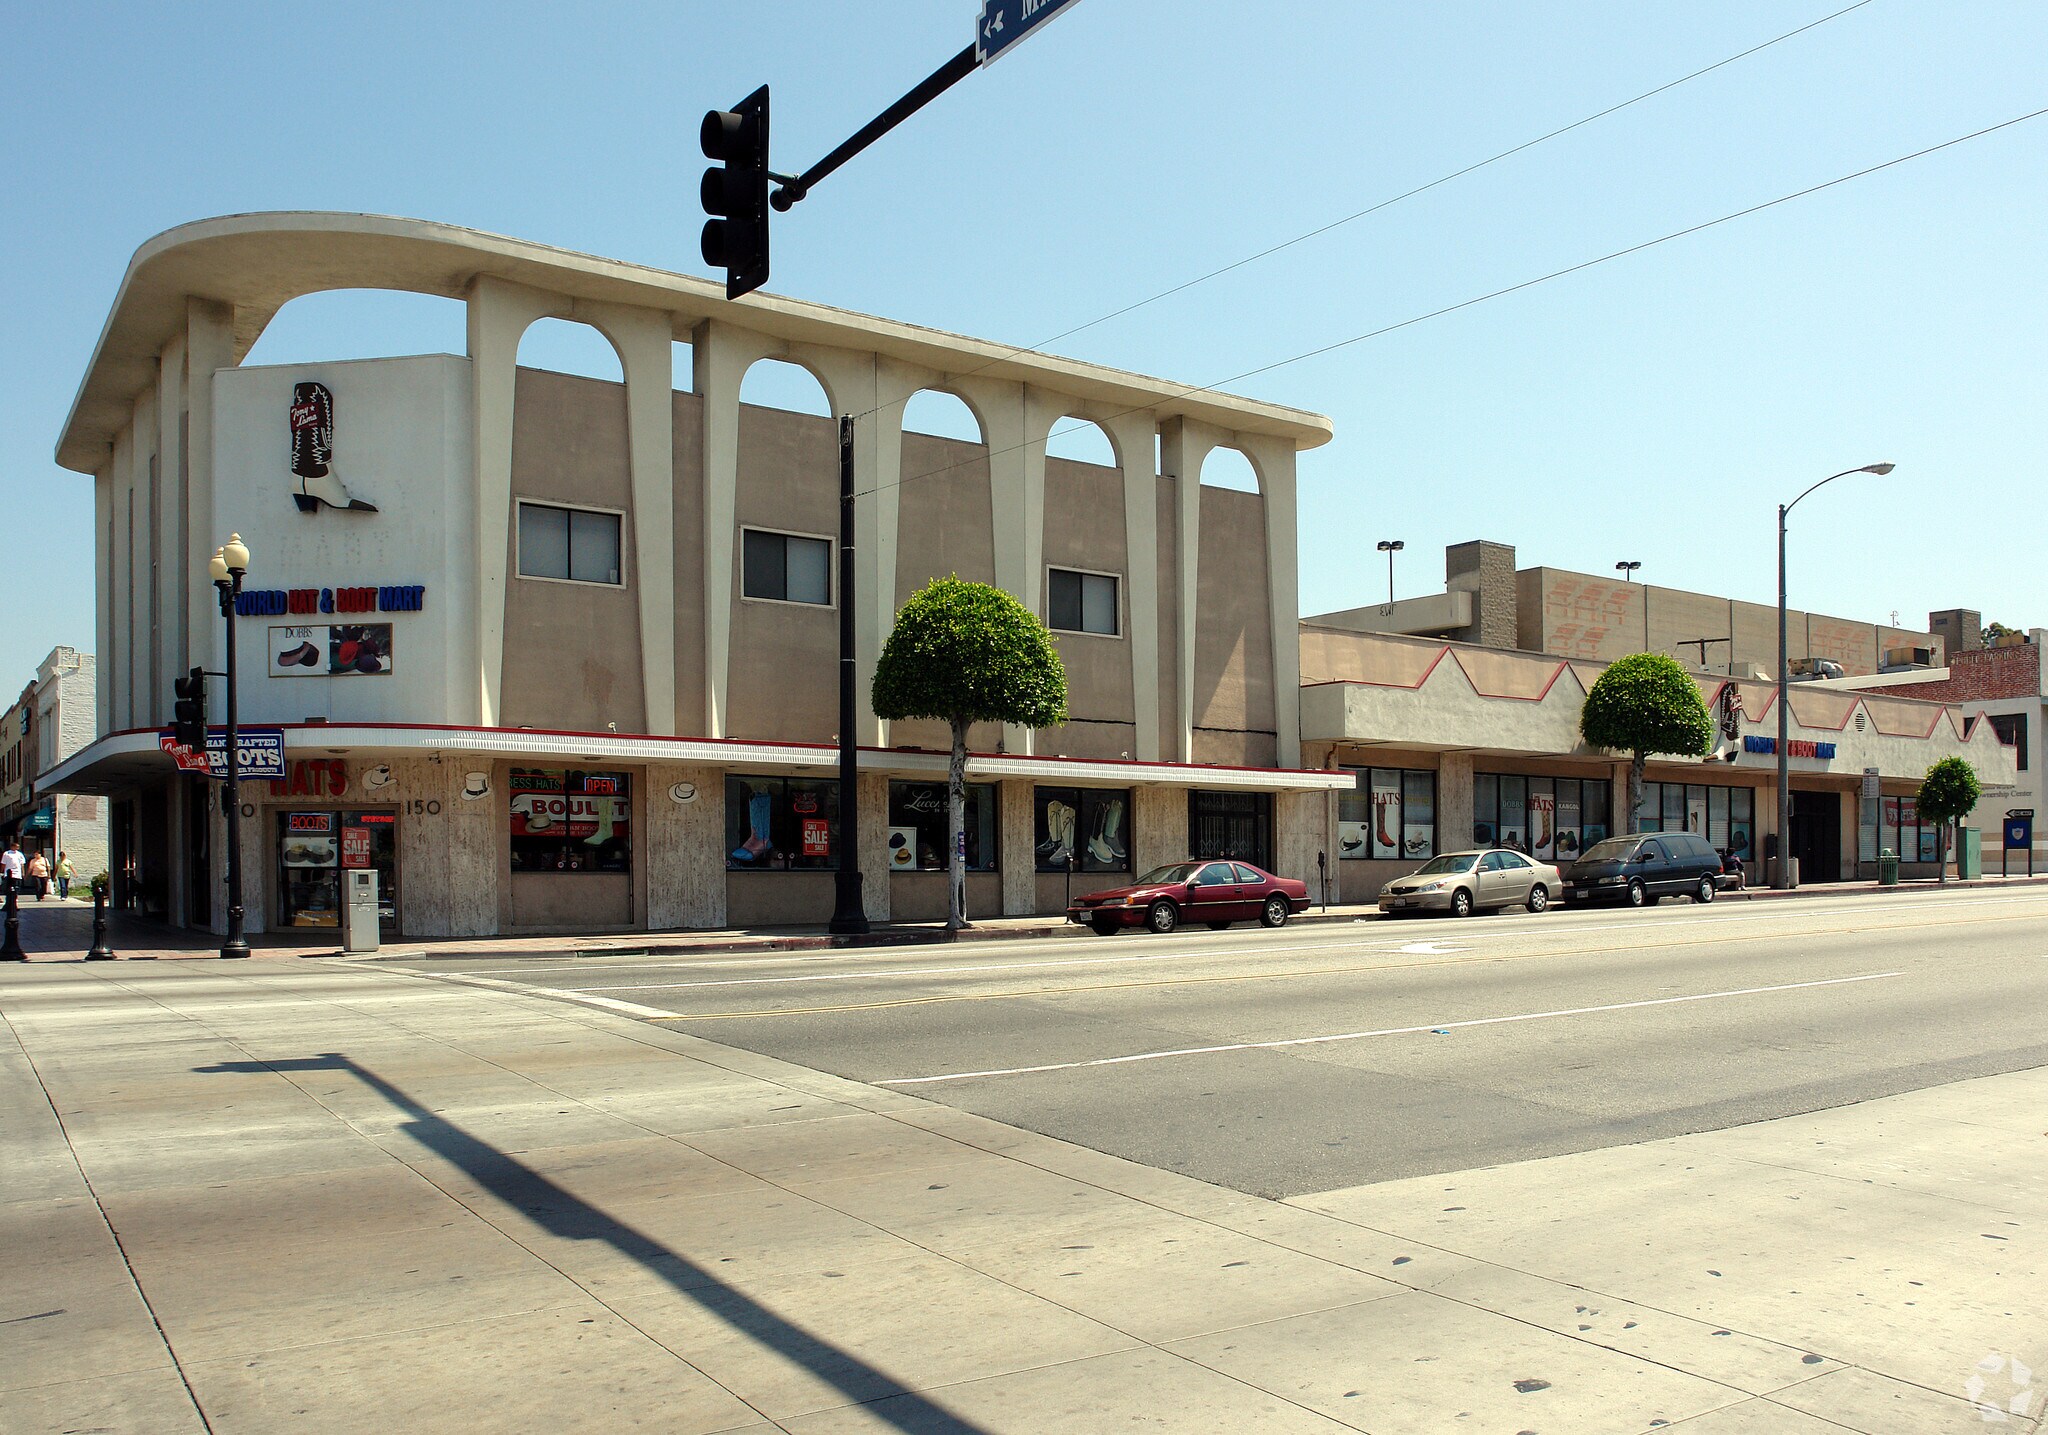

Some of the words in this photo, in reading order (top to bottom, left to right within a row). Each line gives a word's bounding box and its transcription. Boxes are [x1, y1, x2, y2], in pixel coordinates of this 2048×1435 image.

[235, 590, 288, 616] WORLD
[288, 589, 319, 614] HAT
[320, 588, 335, 614] &
[336, 587, 378, 613] BOOT
[379, 586, 425, 612] MART
[285, 627, 313, 638] DOBBS
[206, 738, 278, 748] HANRAFTED
[1744, 735, 1775, 755] WORLD
[1797, 741, 1817, 759] BOOT
[182, 753, 206, 768] La
[510, 778, 531, 789] RESS
[535, 779, 560, 790] HATS
[586, 779, 616, 794] OPEN
[1371, 792, 1400, 805] HATS
[1979, 788, 2010, 799] wnership
[406, 800, 441, 815] 150
[531, 800, 628, 816] BOULT
[1528, 799, 1554, 812] HATS
[291, 815, 328, 830] BOOTS
[804, 830, 828, 844] SALE
[343, 839, 370, 855] SALE
